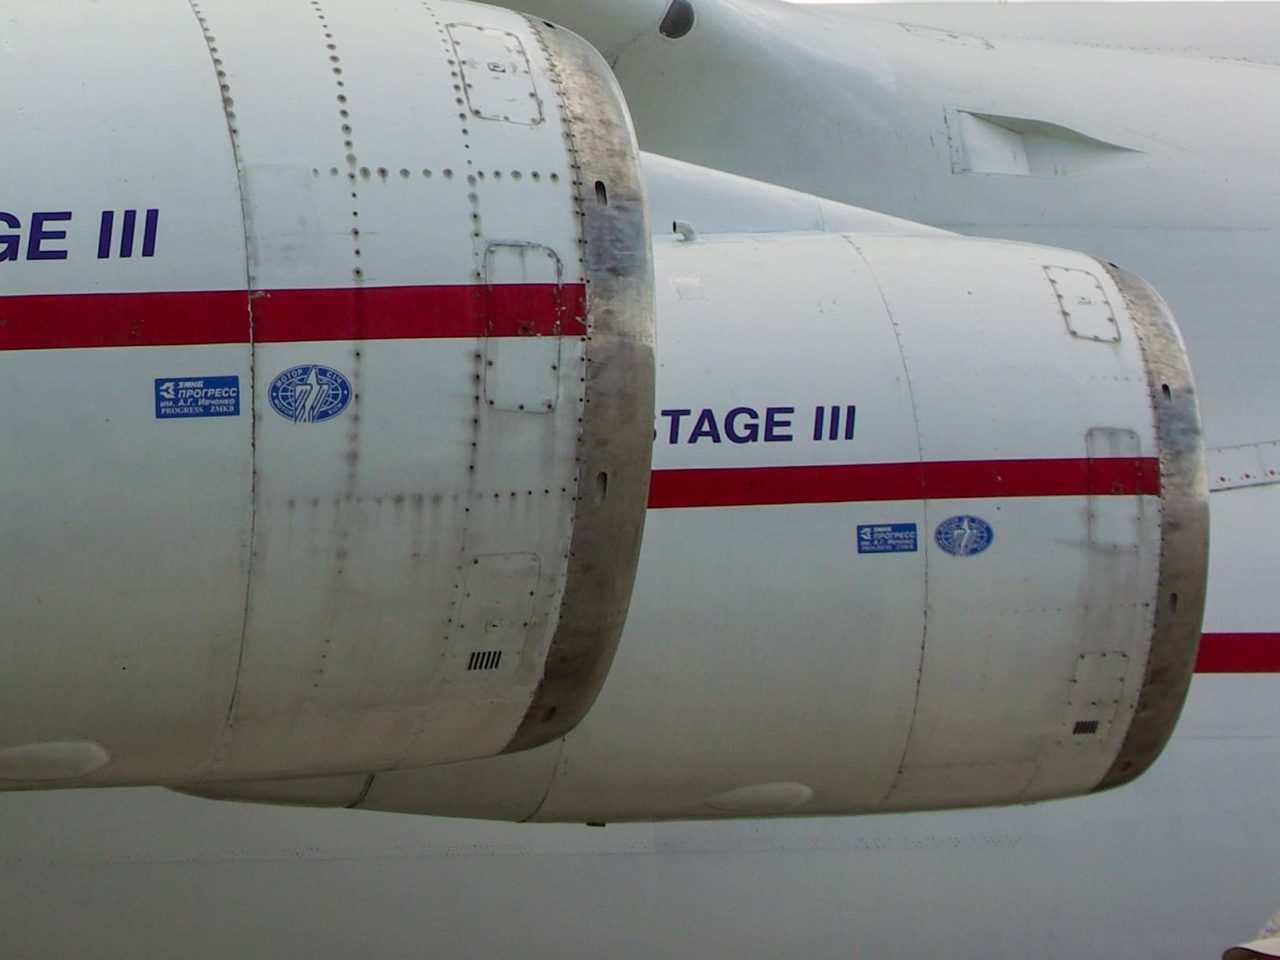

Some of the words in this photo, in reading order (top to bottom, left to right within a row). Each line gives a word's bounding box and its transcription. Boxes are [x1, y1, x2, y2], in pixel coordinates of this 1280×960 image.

[97, 209, 159, 259] III
[178, 388, 237, 398] ПРОГРЕСС
[161, 407, 204, 415] PROGRESS
[653, 407, 795, 445] TAGE
[813, 405, 856, 441] III
